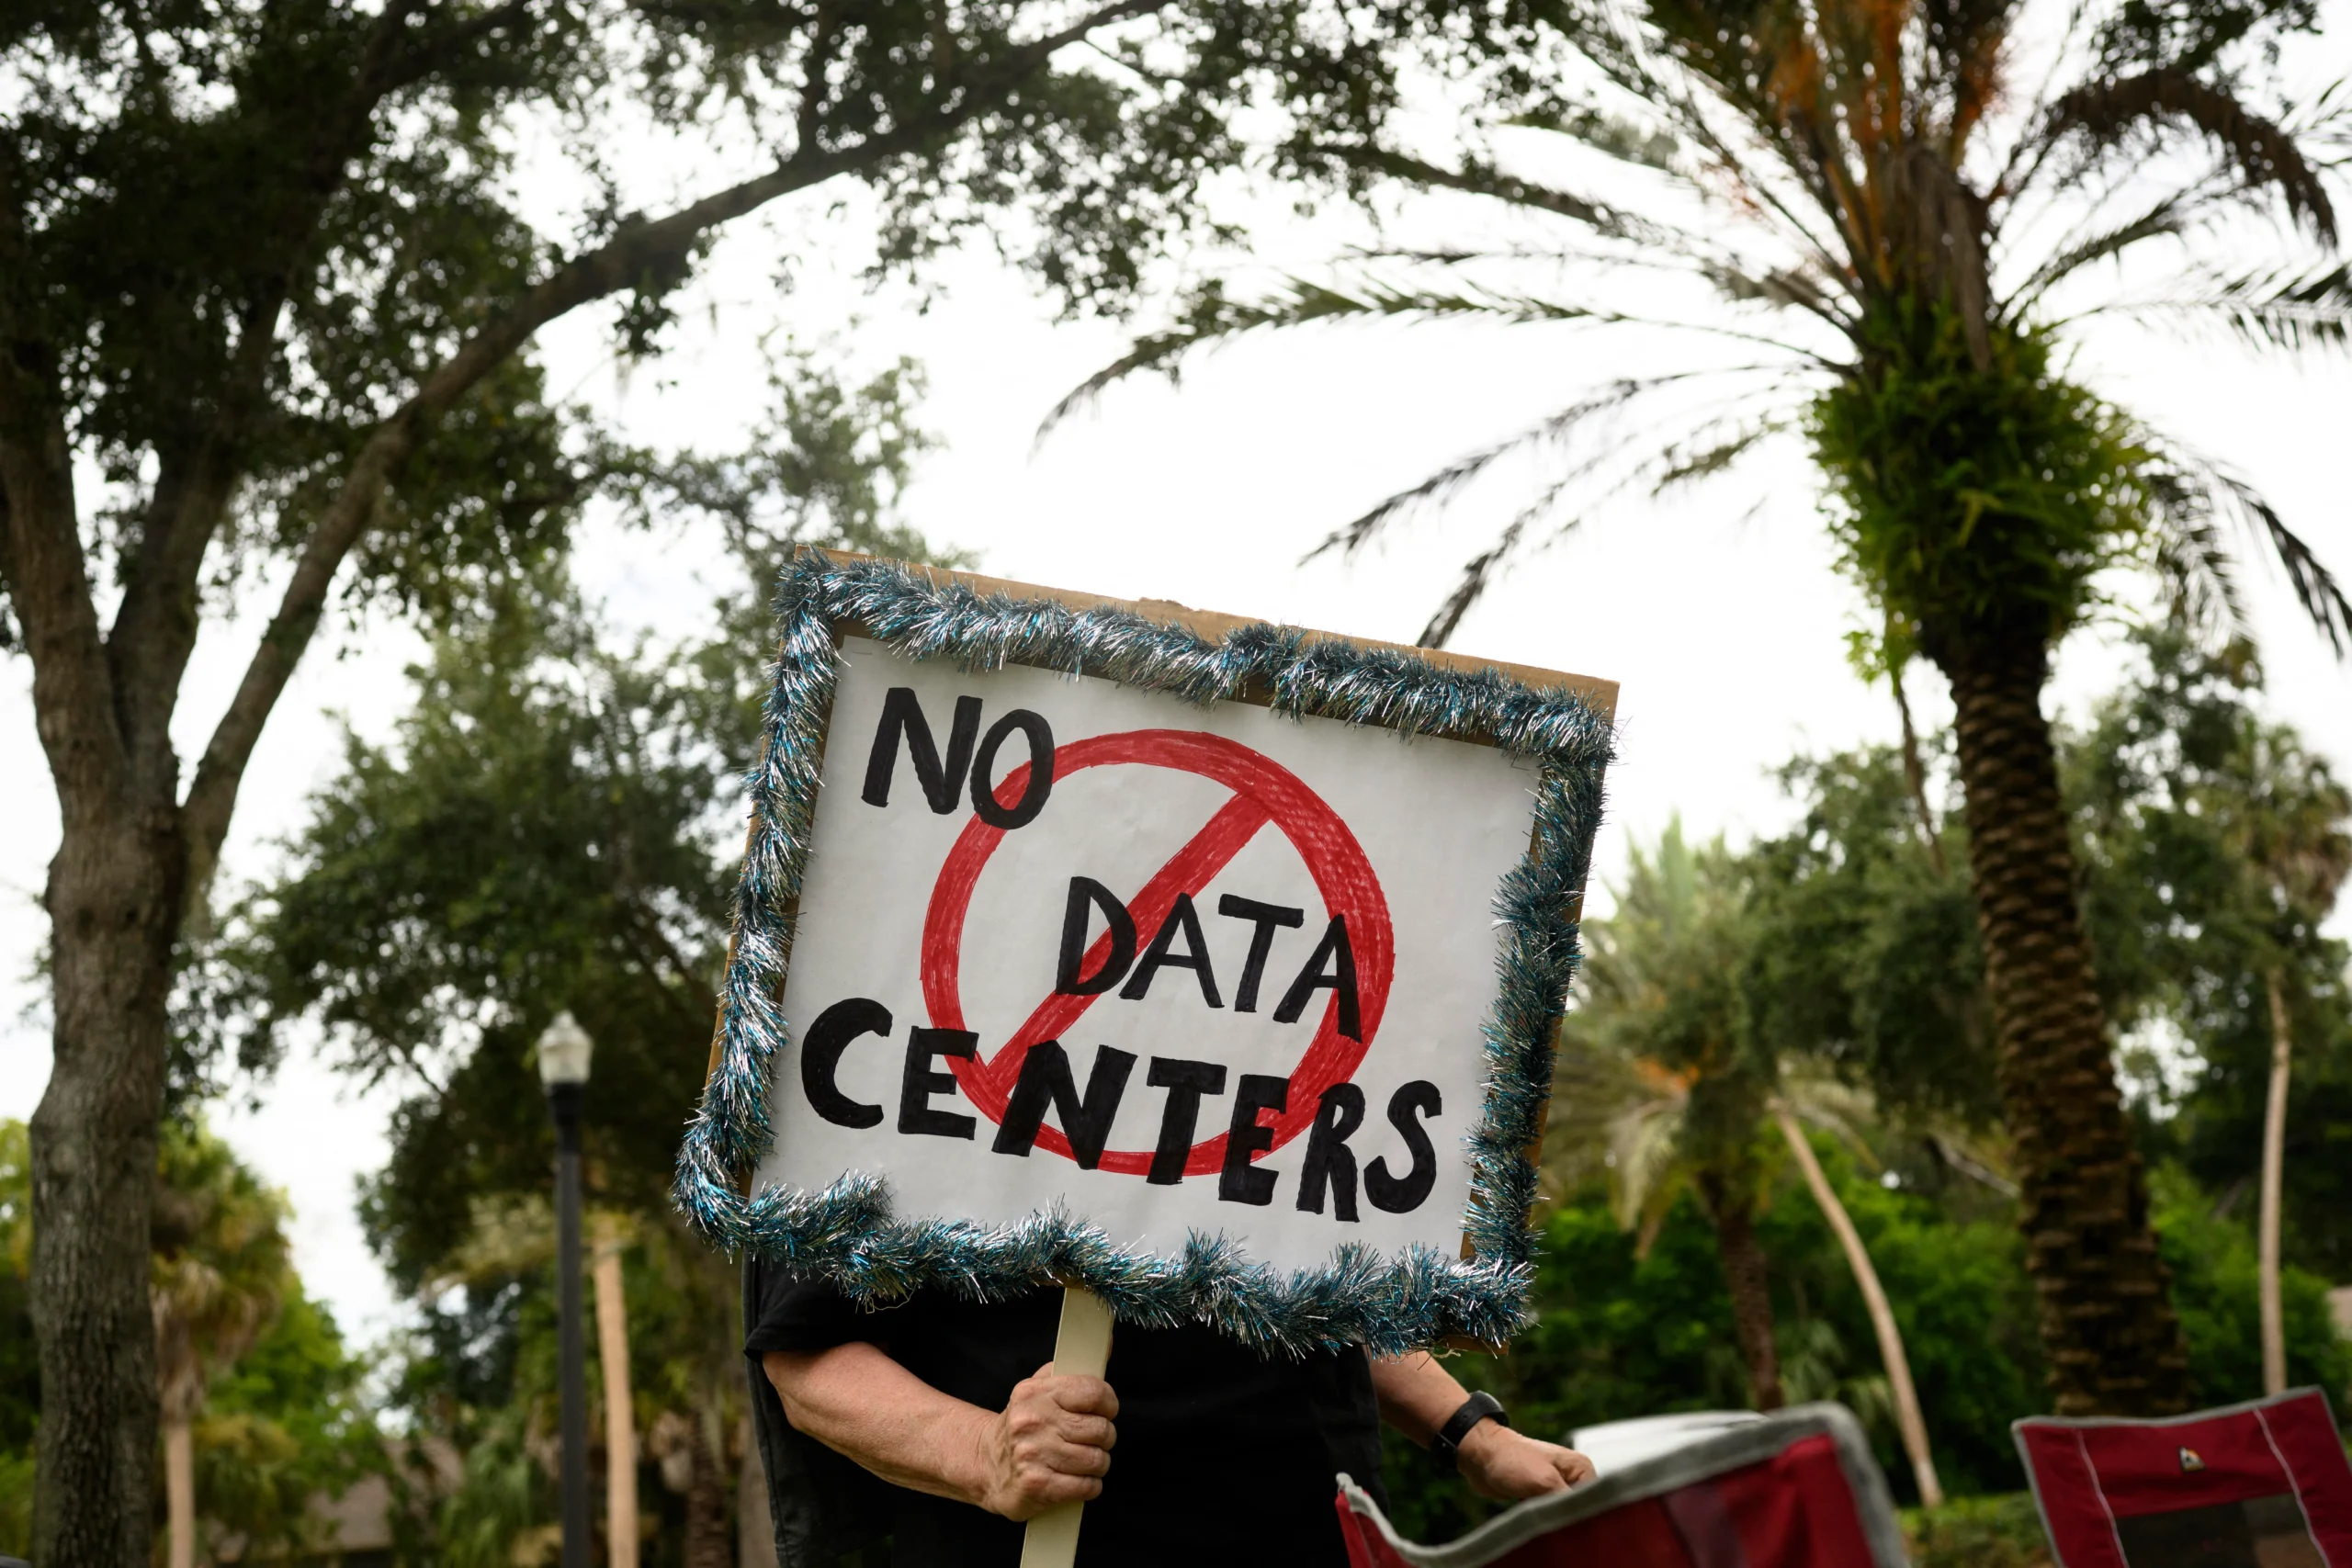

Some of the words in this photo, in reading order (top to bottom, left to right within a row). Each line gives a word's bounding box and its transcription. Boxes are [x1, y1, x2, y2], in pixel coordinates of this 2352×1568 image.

[862, 687, 1054, 829] NO
[1055, 876, 1362, 1043] DATA
[801, 998, 1442, 1223] CENTERS
